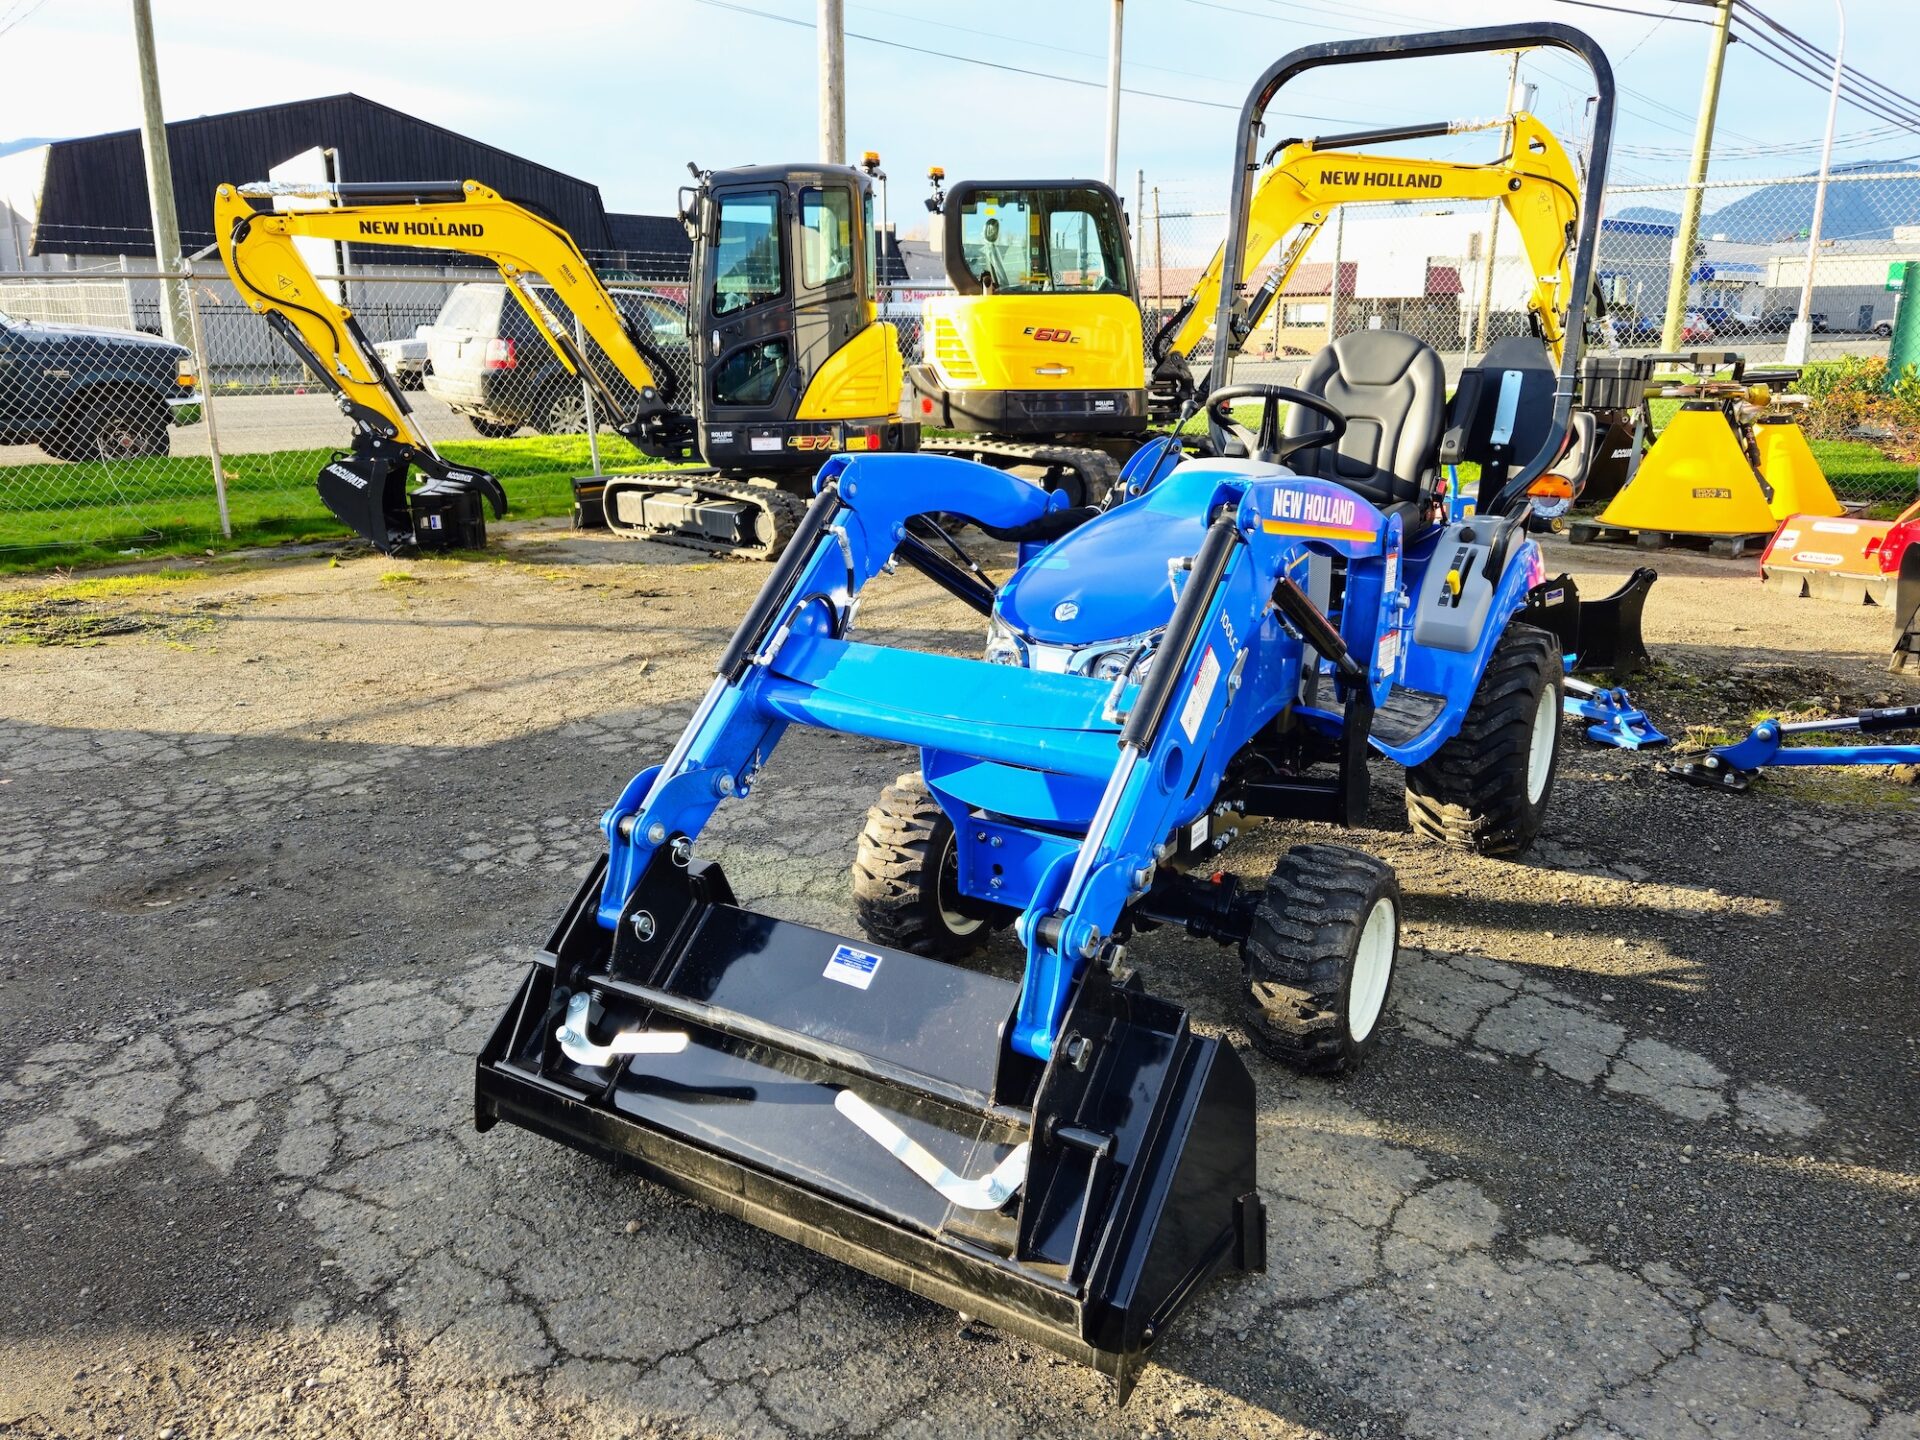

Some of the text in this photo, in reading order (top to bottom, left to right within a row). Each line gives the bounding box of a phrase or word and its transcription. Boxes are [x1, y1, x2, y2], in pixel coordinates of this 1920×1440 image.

[1320, 170, 1443, 189] NEW HOLLAND
[359, 220, 484, 237] NEW HOLLAND
[1610, 448, 1633, 459] ACCUR
[326, 462, 368, 490] ACCURATE
[446, 470, 473, 483] ACCURATE
[1272, 487, 1355, 526] NEW HOLLAND
[1220, 608, 1239, 653] 100LC
